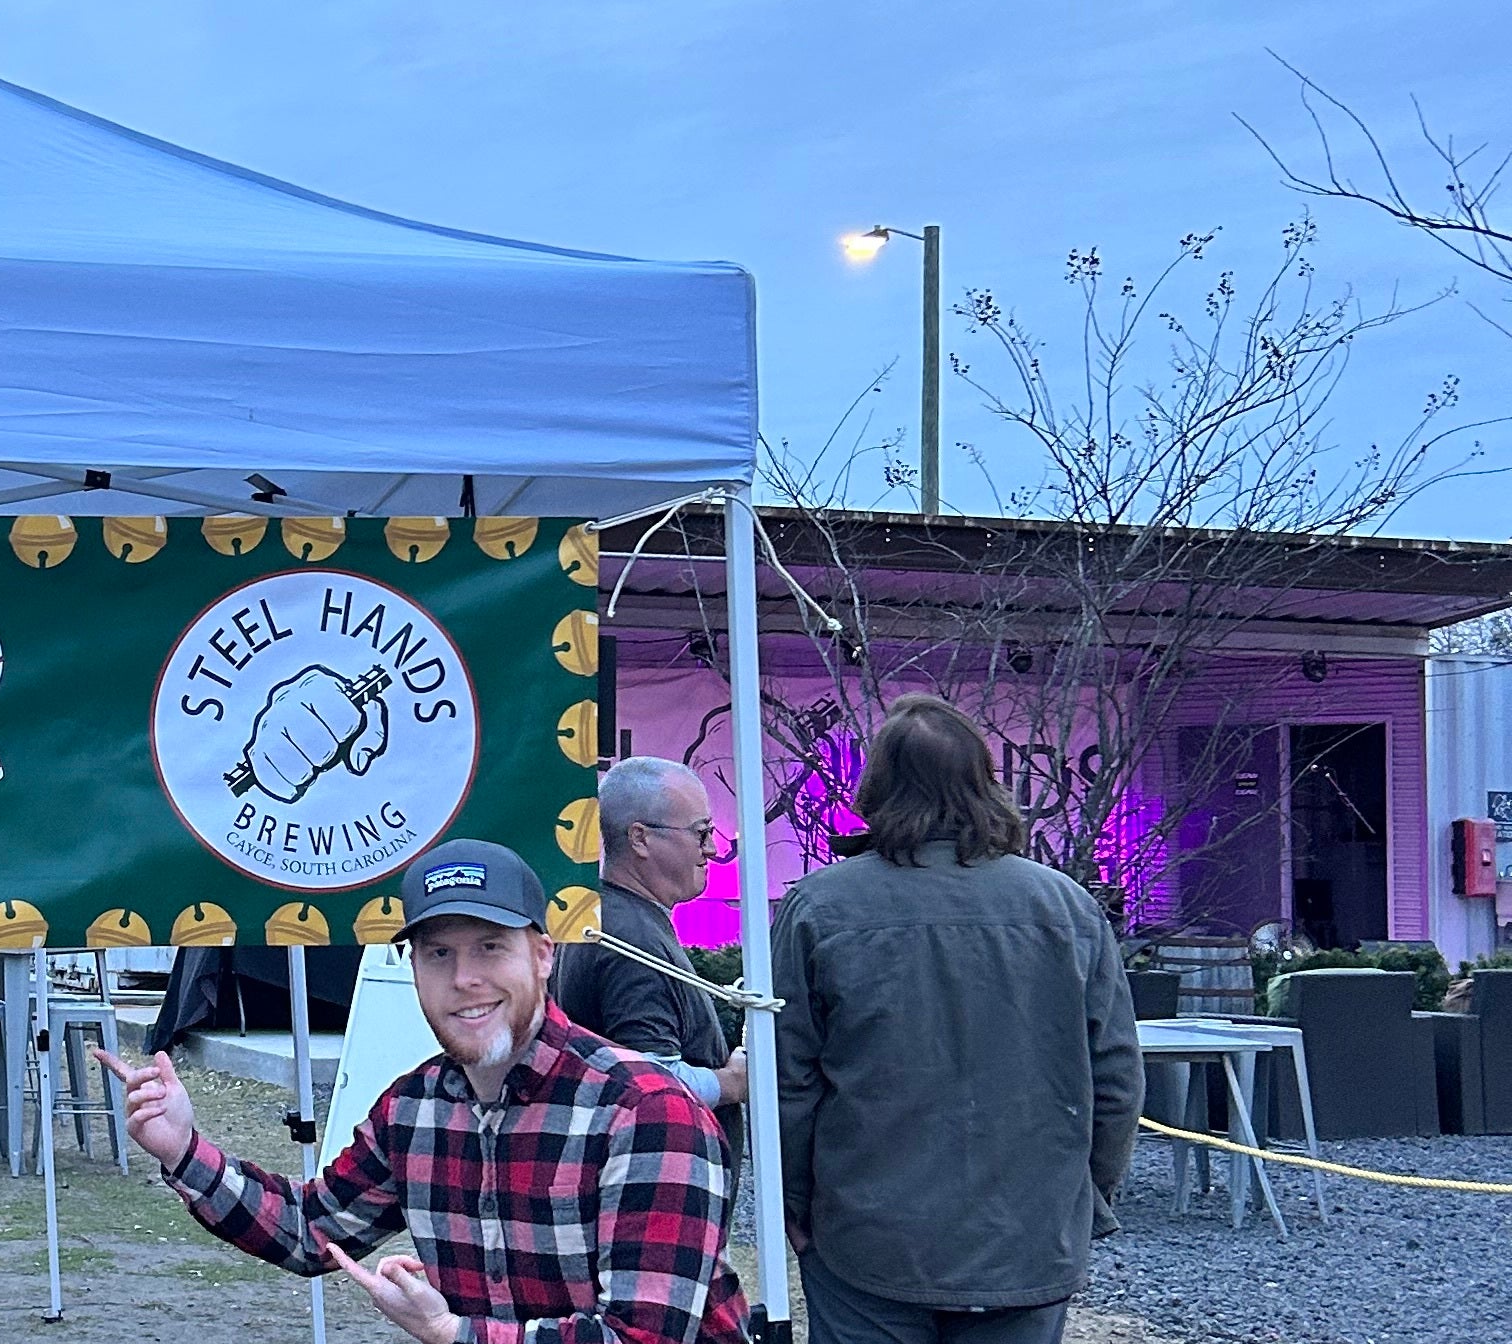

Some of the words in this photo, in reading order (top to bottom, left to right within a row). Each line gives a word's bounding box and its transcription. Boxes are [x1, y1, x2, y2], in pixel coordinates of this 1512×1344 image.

[181, 598, 294, 722] STEEL
[320, 588, 457, 724] HANDS
[225, 830, 276, 870] CAYCE,
[279, 858, 337, 876] SOUTH
[340, 828, 418, 874] CAROLINA
[233, 801, 407, 857] BREWING
